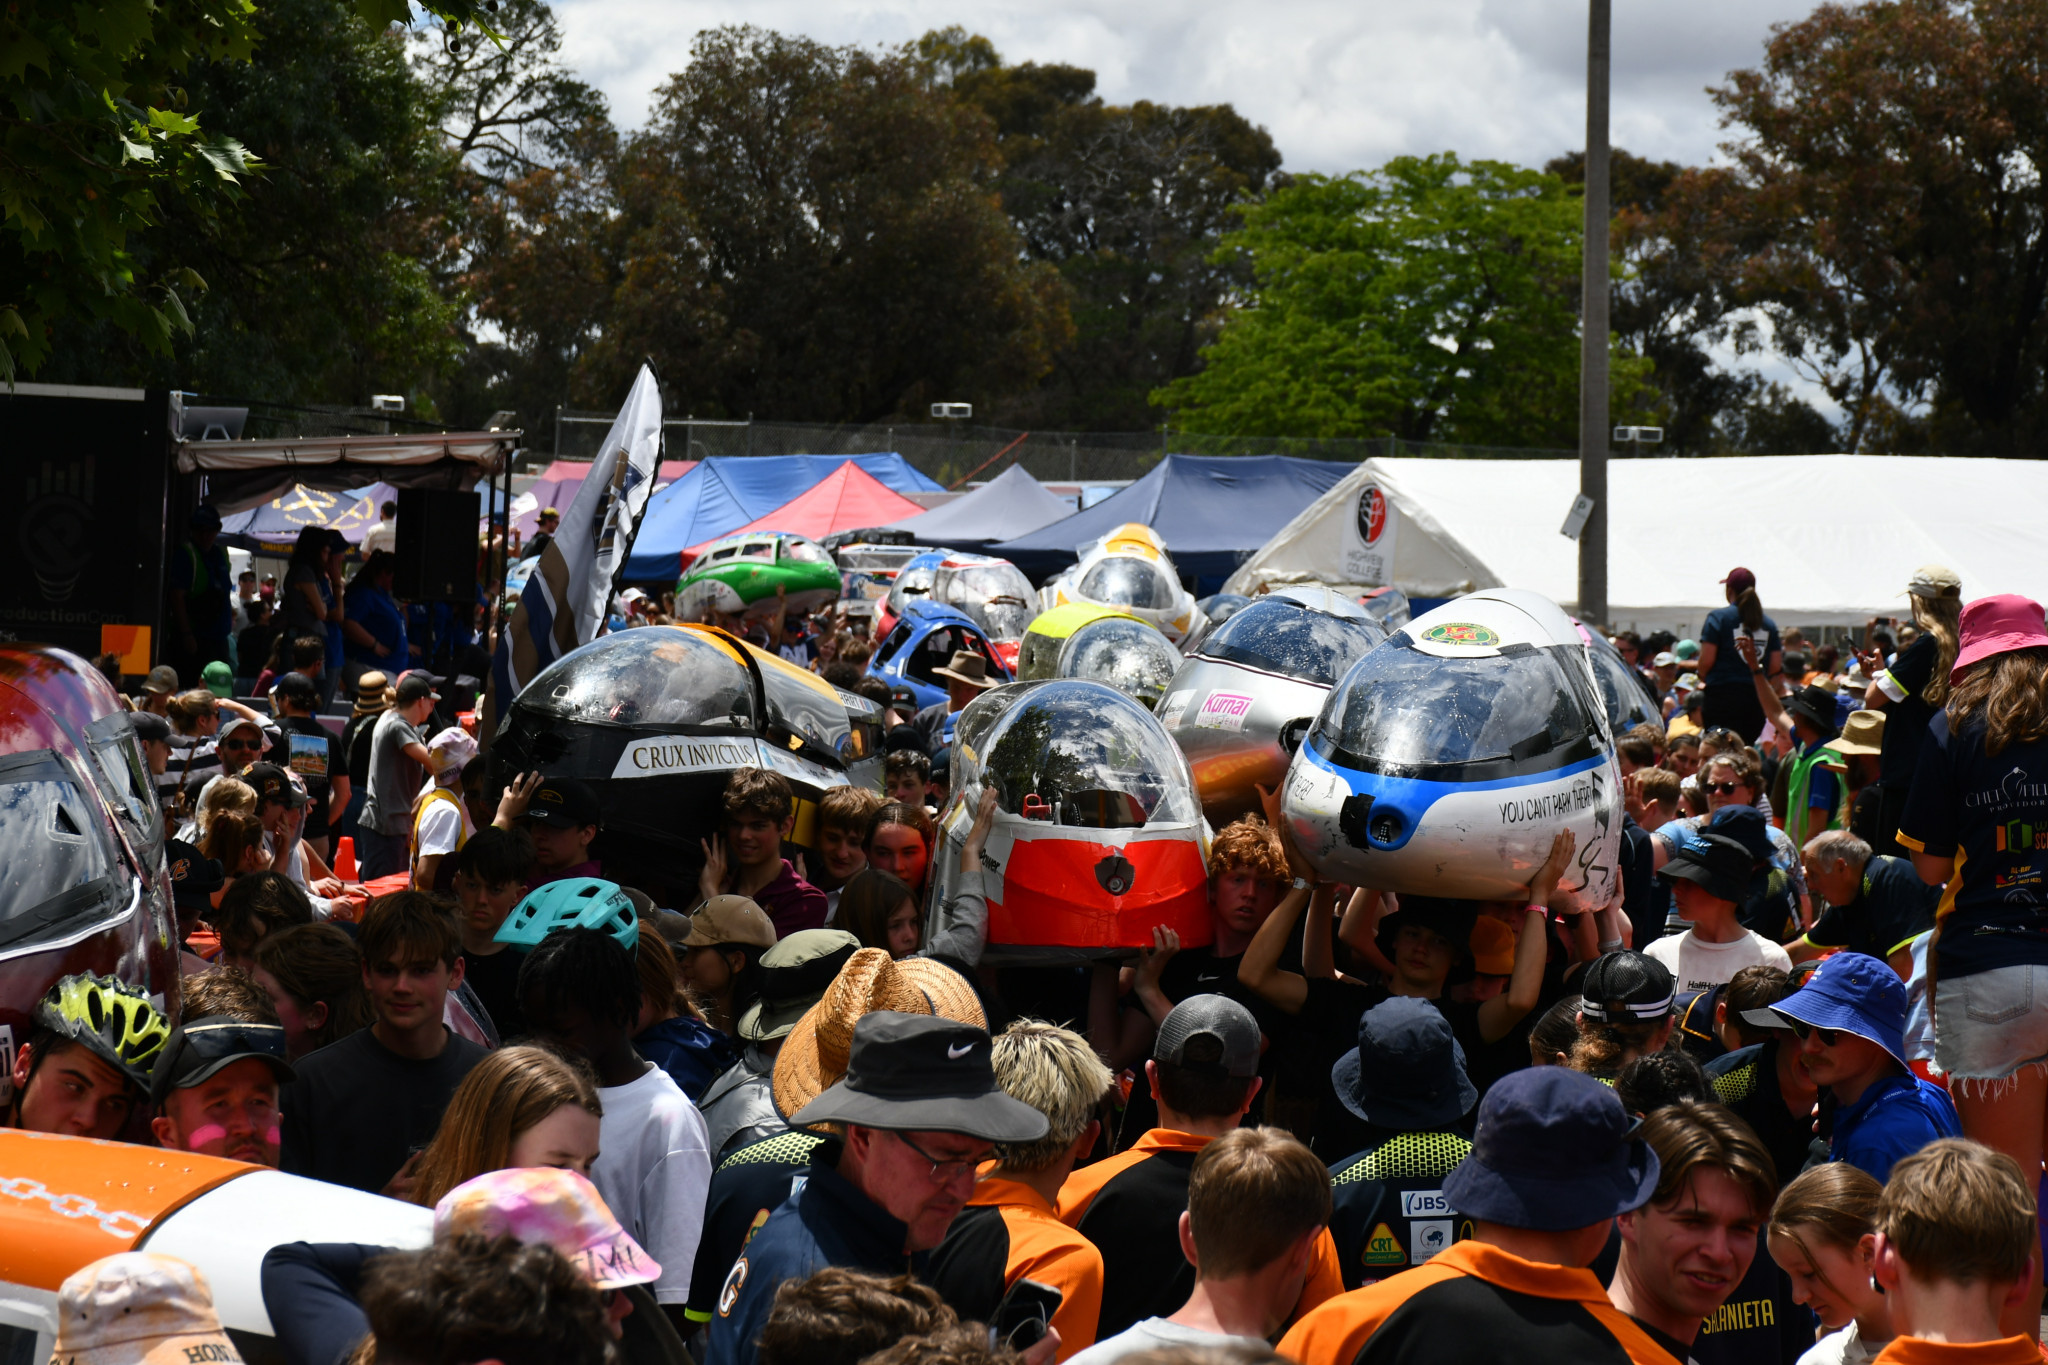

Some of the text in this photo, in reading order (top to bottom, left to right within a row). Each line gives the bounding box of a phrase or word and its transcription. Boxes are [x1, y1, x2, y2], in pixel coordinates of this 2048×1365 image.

[1202, 693, 1254, 716] Kurnai
[632, 745, 687, 770] CRUX
[687, 744, 756, 766] INVICTUS
[1499, 801, 1525, 824] YOU
[1526, 796, 1552, 820] CAN'T
[1553, 791, 1573, 816] PARK
[1371, 1238, 1393, 1252] CRT
